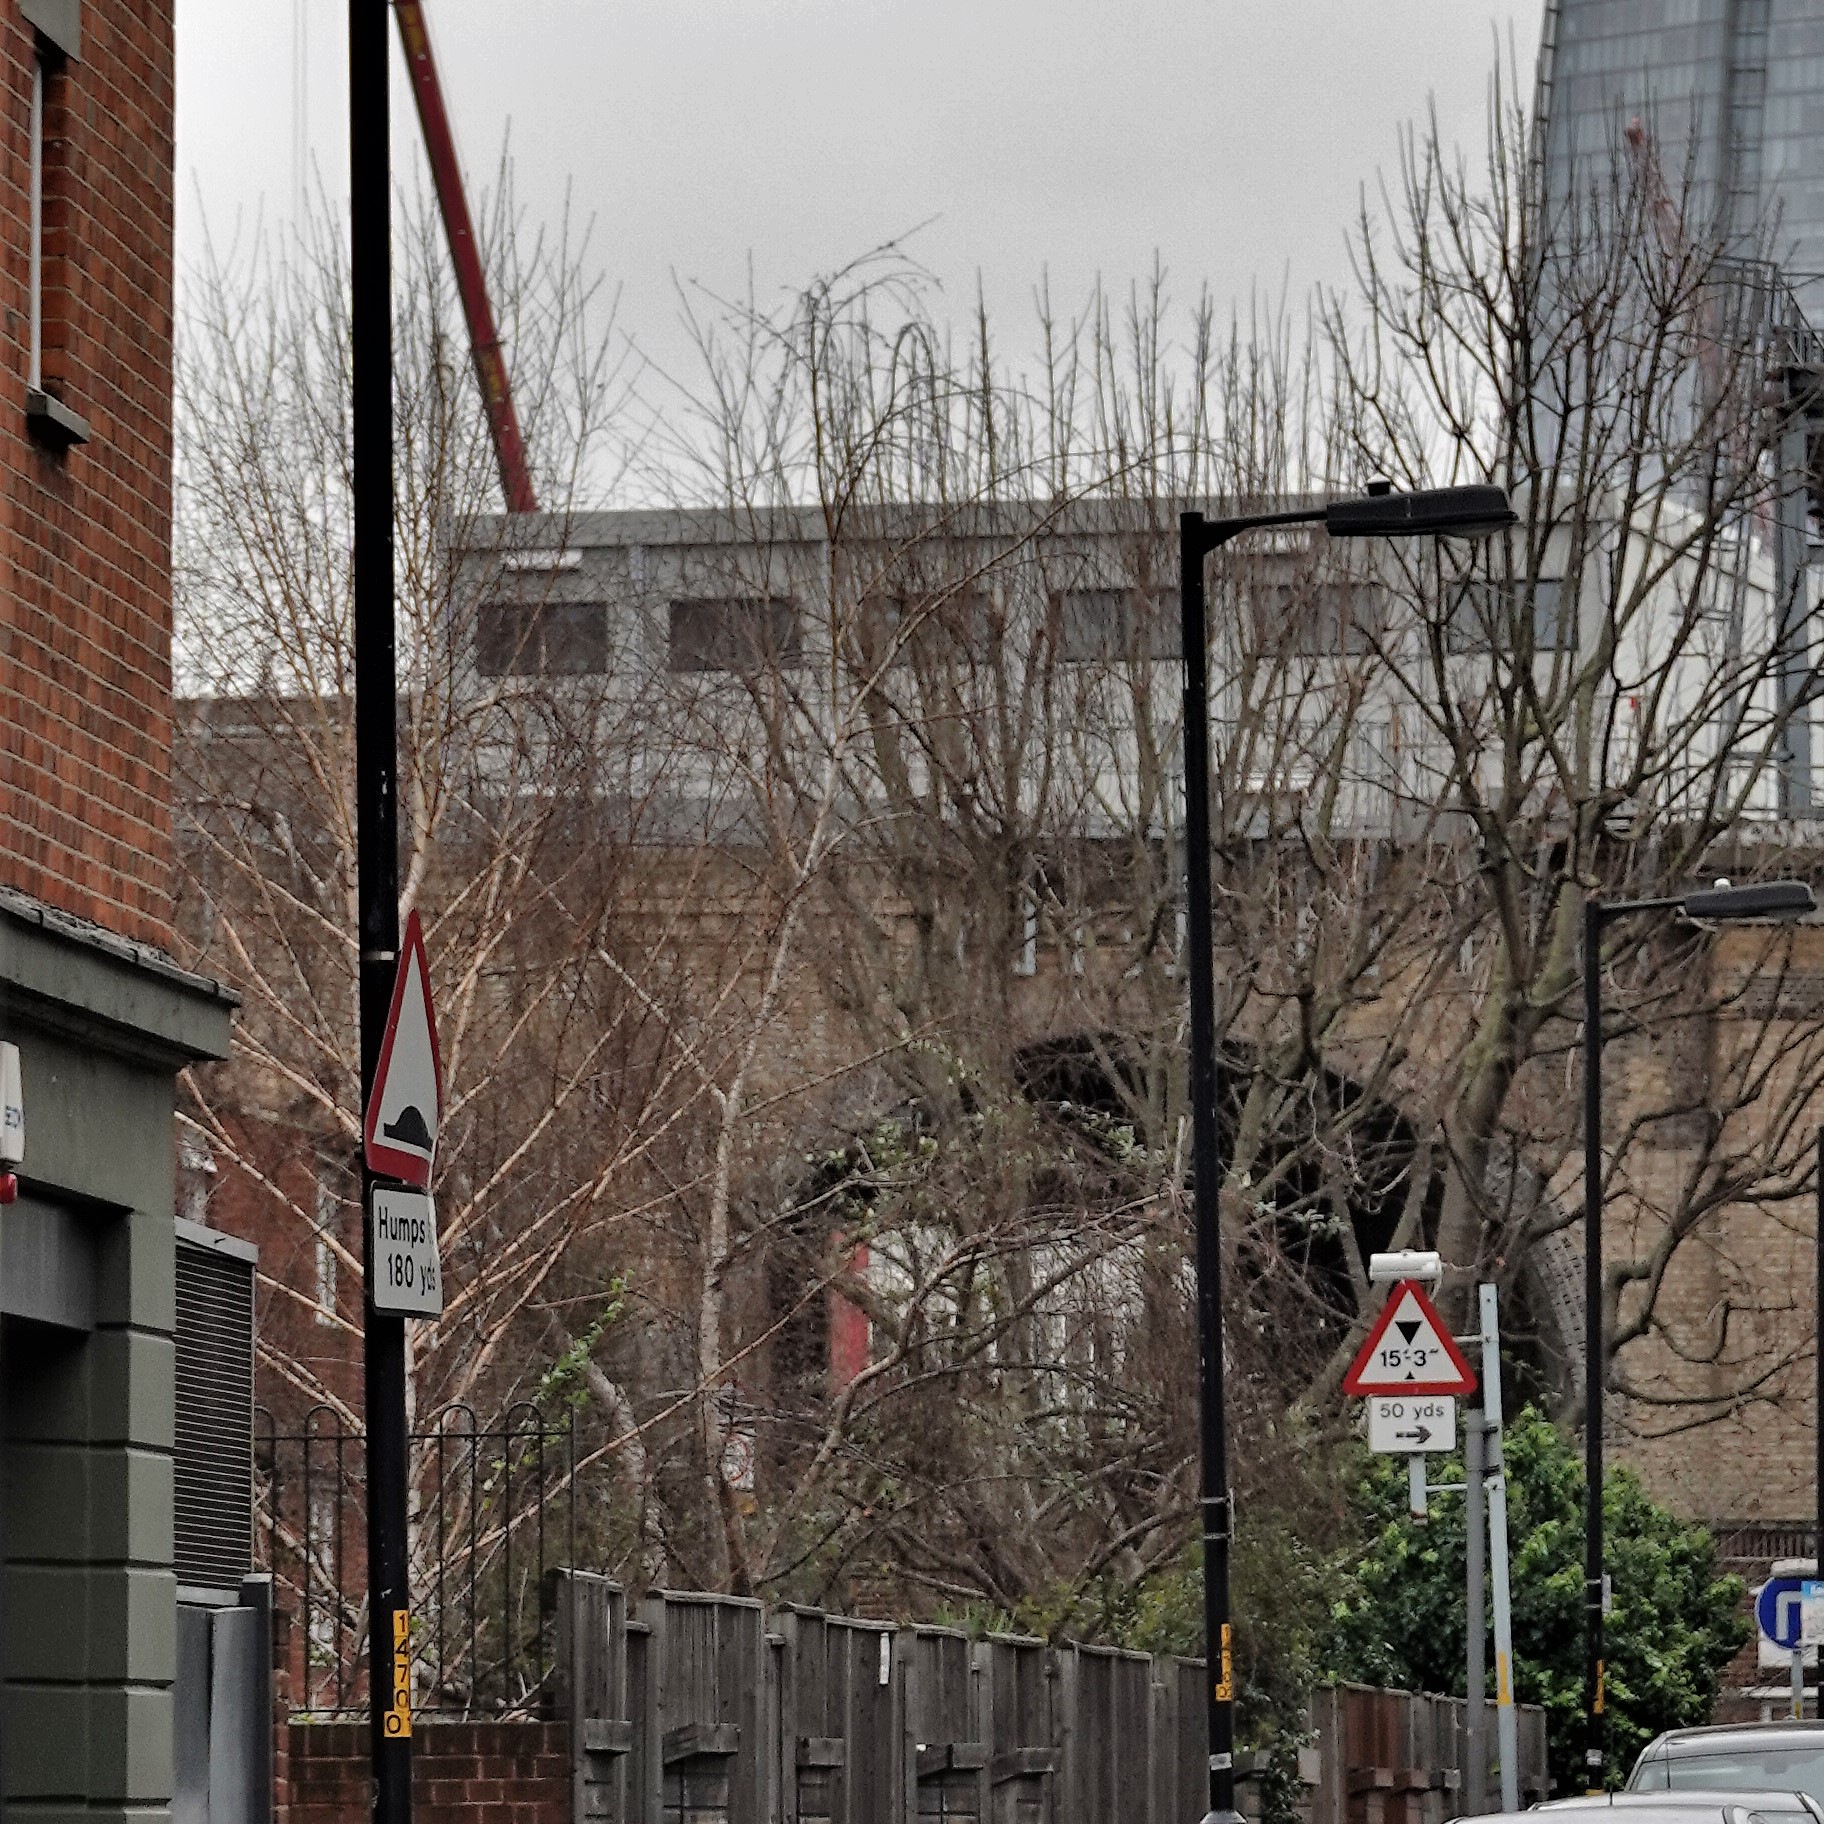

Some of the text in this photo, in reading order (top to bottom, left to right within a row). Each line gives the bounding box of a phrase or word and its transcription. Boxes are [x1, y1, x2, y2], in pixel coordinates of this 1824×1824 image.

[378, 1205, 426, 1249] Humps
[387, 1252, 414, 1288] 180
[1380, 1402, 1445, 1420] 50 yds
